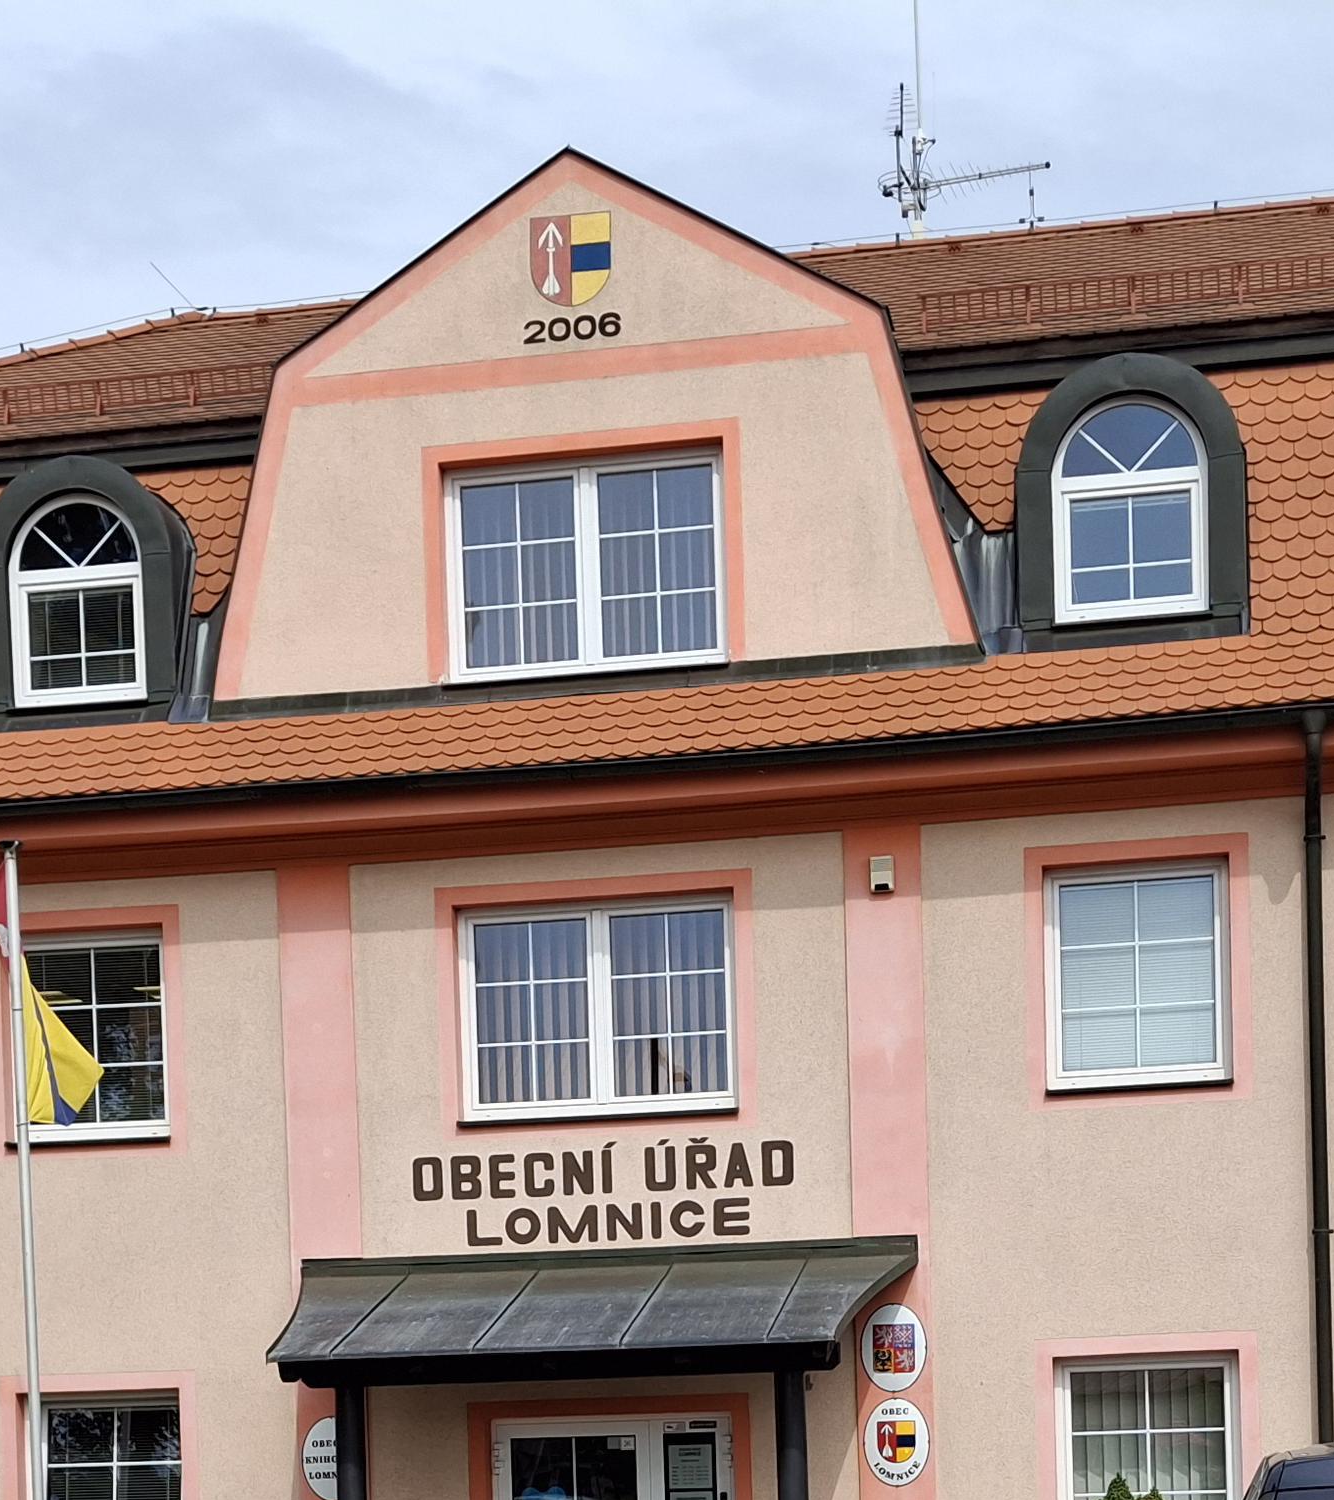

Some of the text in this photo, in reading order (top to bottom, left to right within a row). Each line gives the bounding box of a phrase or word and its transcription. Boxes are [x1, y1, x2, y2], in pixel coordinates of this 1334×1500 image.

[523, 312, 621, 345] 2006
[412, 1137, 794, 1202] OBECNÍ ÚŘAD
[467, 1197, 751, 1246] LOMNICE
[881, 1407, 909, 1416] OBEC
[874, 1460, 921, 1481] LOMNICE
